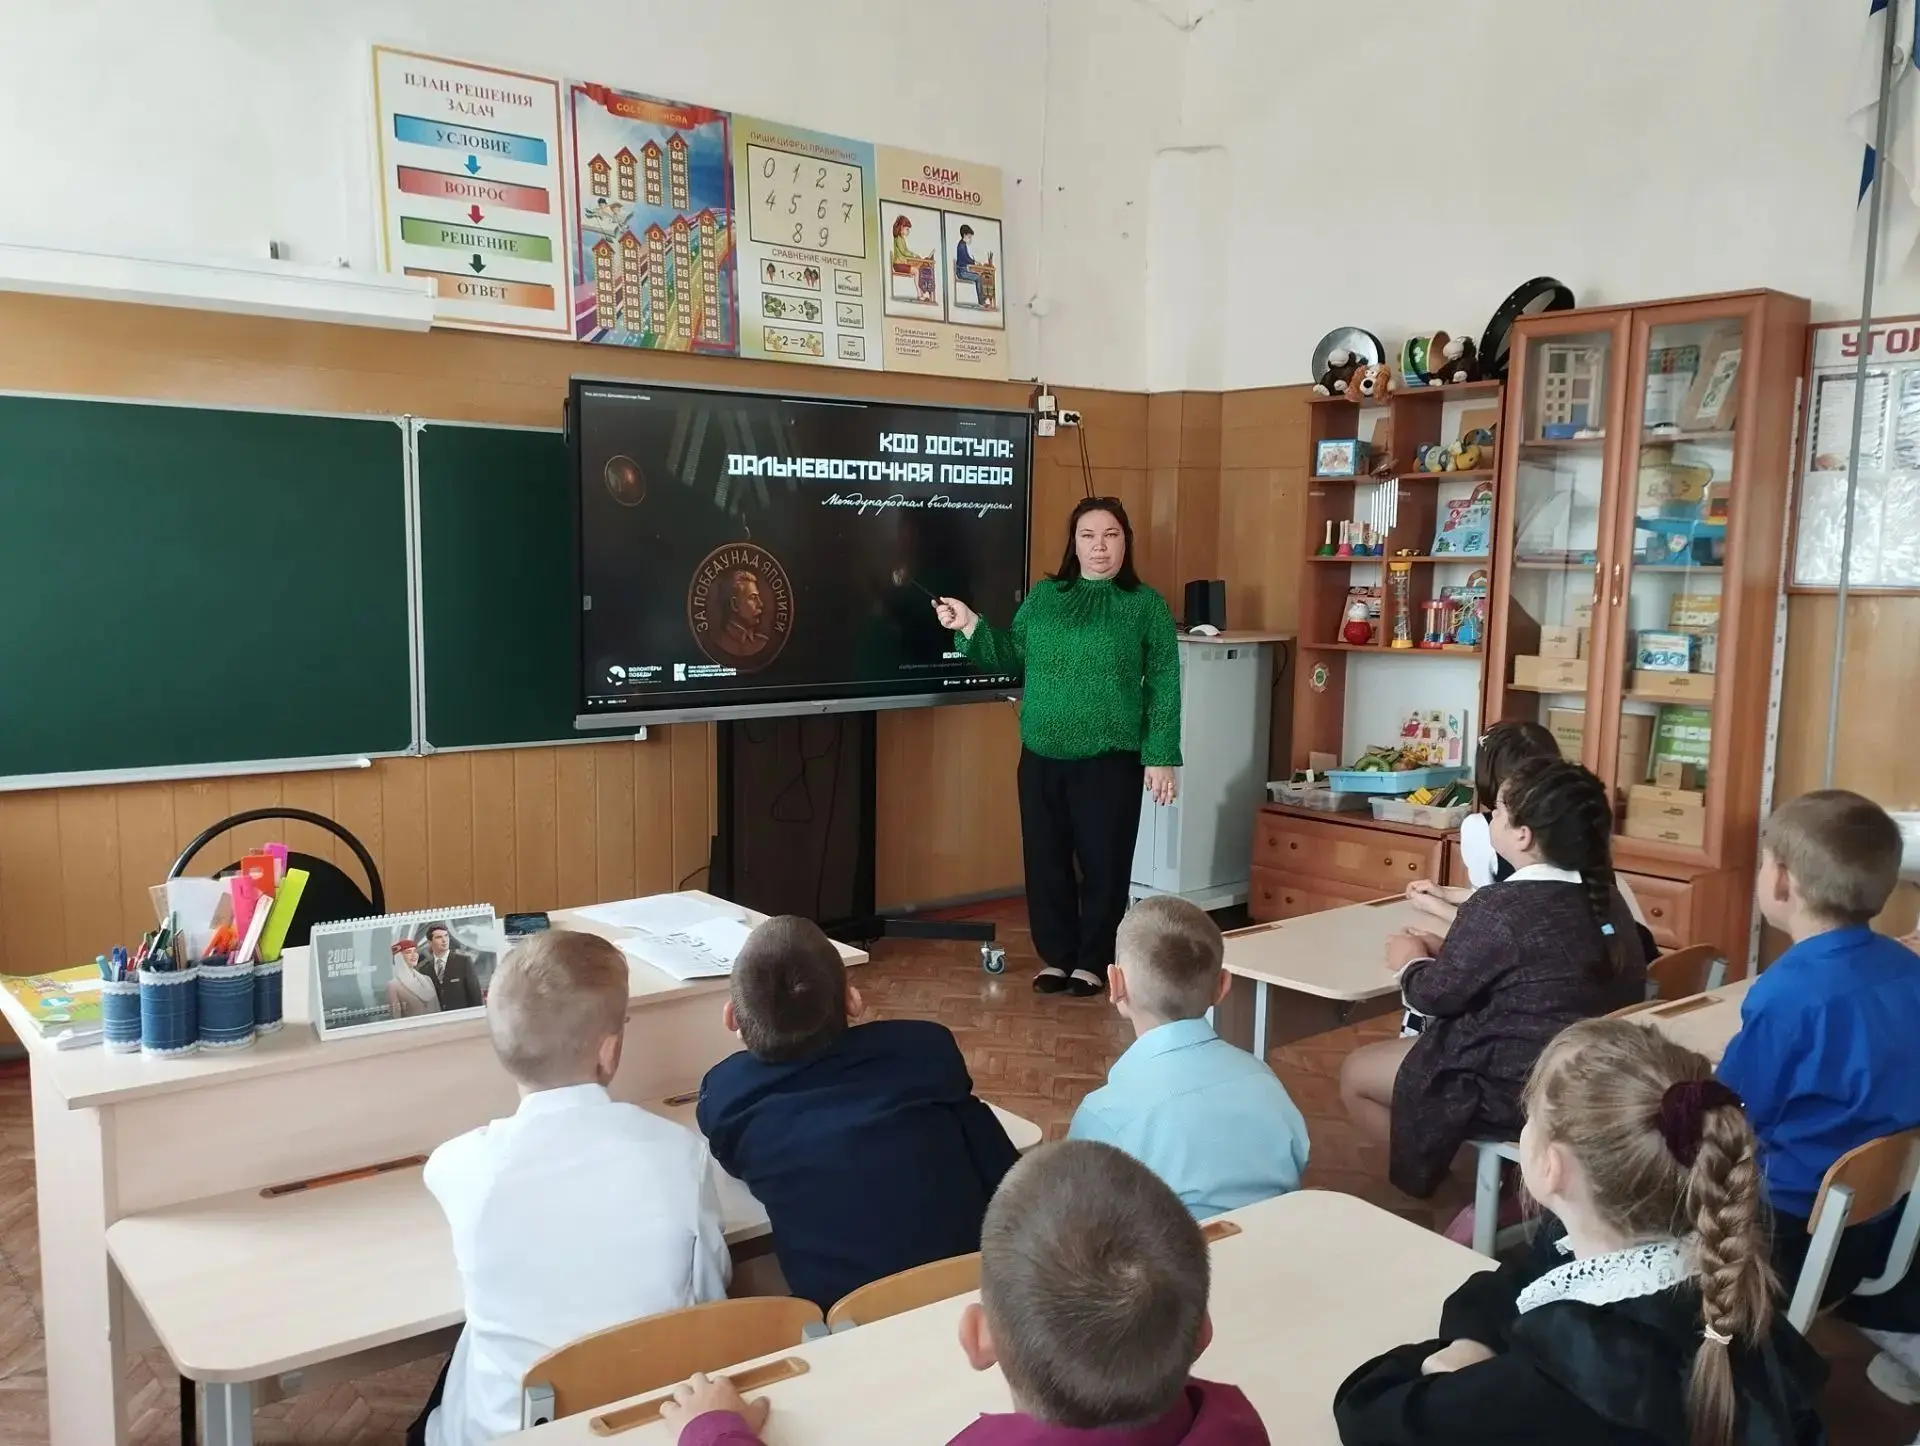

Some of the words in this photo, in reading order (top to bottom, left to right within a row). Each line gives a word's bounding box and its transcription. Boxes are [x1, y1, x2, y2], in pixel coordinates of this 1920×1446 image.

[404, 72, 450, 92] ПЛАН
[455, 82, 533, 107] РЕШЕНИЯ
[447, 98, 495, 118] ЗАДАЧ
[436, 129, 512, 154] УСЛОВИЕ
[750, 131, 776, 143] ПИШИ
[777, 137, 807, 151] ЦИФРЫ
[808, 143, 857, 160] ПРАВИЛЬНО
[763, 157, 775, 178] 0
[793, 163, 801, 183] 1
[815, 167, 827, 188] 2
[842, 172, 853, 193] 3
[922, 165, 959, 182] СИДИ
[445, 181, 508, 201] ВОПРОС
[901, 179, 981, 203] ПРАВИЛЬНО
[765, 189, 776, 211] 4
[788, 193, 801, 214] 5
[817, 199, 827, 219] 6
[841, 202, 853, 223] 7
[441, 230, 518, 252] РЕШЕНИЕ
[792, 222, 803, 243] 8
[819, 227, 829, 247] 9
[771, 248, 819, 263] СРАВНЕНИЕ
[821, 256, 848, 267] ЧИСЕЛ
[779, 270, 785, 279] 1
[796, 271, 802, 281] 2
[457, 282, 508, 299] ОТВЕТ
[780, 302, 786, 312] 4
[798, 304, 804, 314] 3
[782, 335, 788, 346] 2
[800, 338, 806, 347] 2
[879, 432, 918, 453] КОД
[925, 435, 1014, 458] ДОСТУПА:
[727, 454, 933, 483] ДАЛЬНЕВОСТОЧНАЯ
[940, 463, 1013, 486] ПОБЕДА
[821, 492, 924, 516] Международная
[730, 549, 760, 569] НАД
[693, 553, 730, 607] ПОБЕДУ
[760, 560, 789, 633] ЯПОНИЕЙ
[694, 610, 709, 633] ЗА
